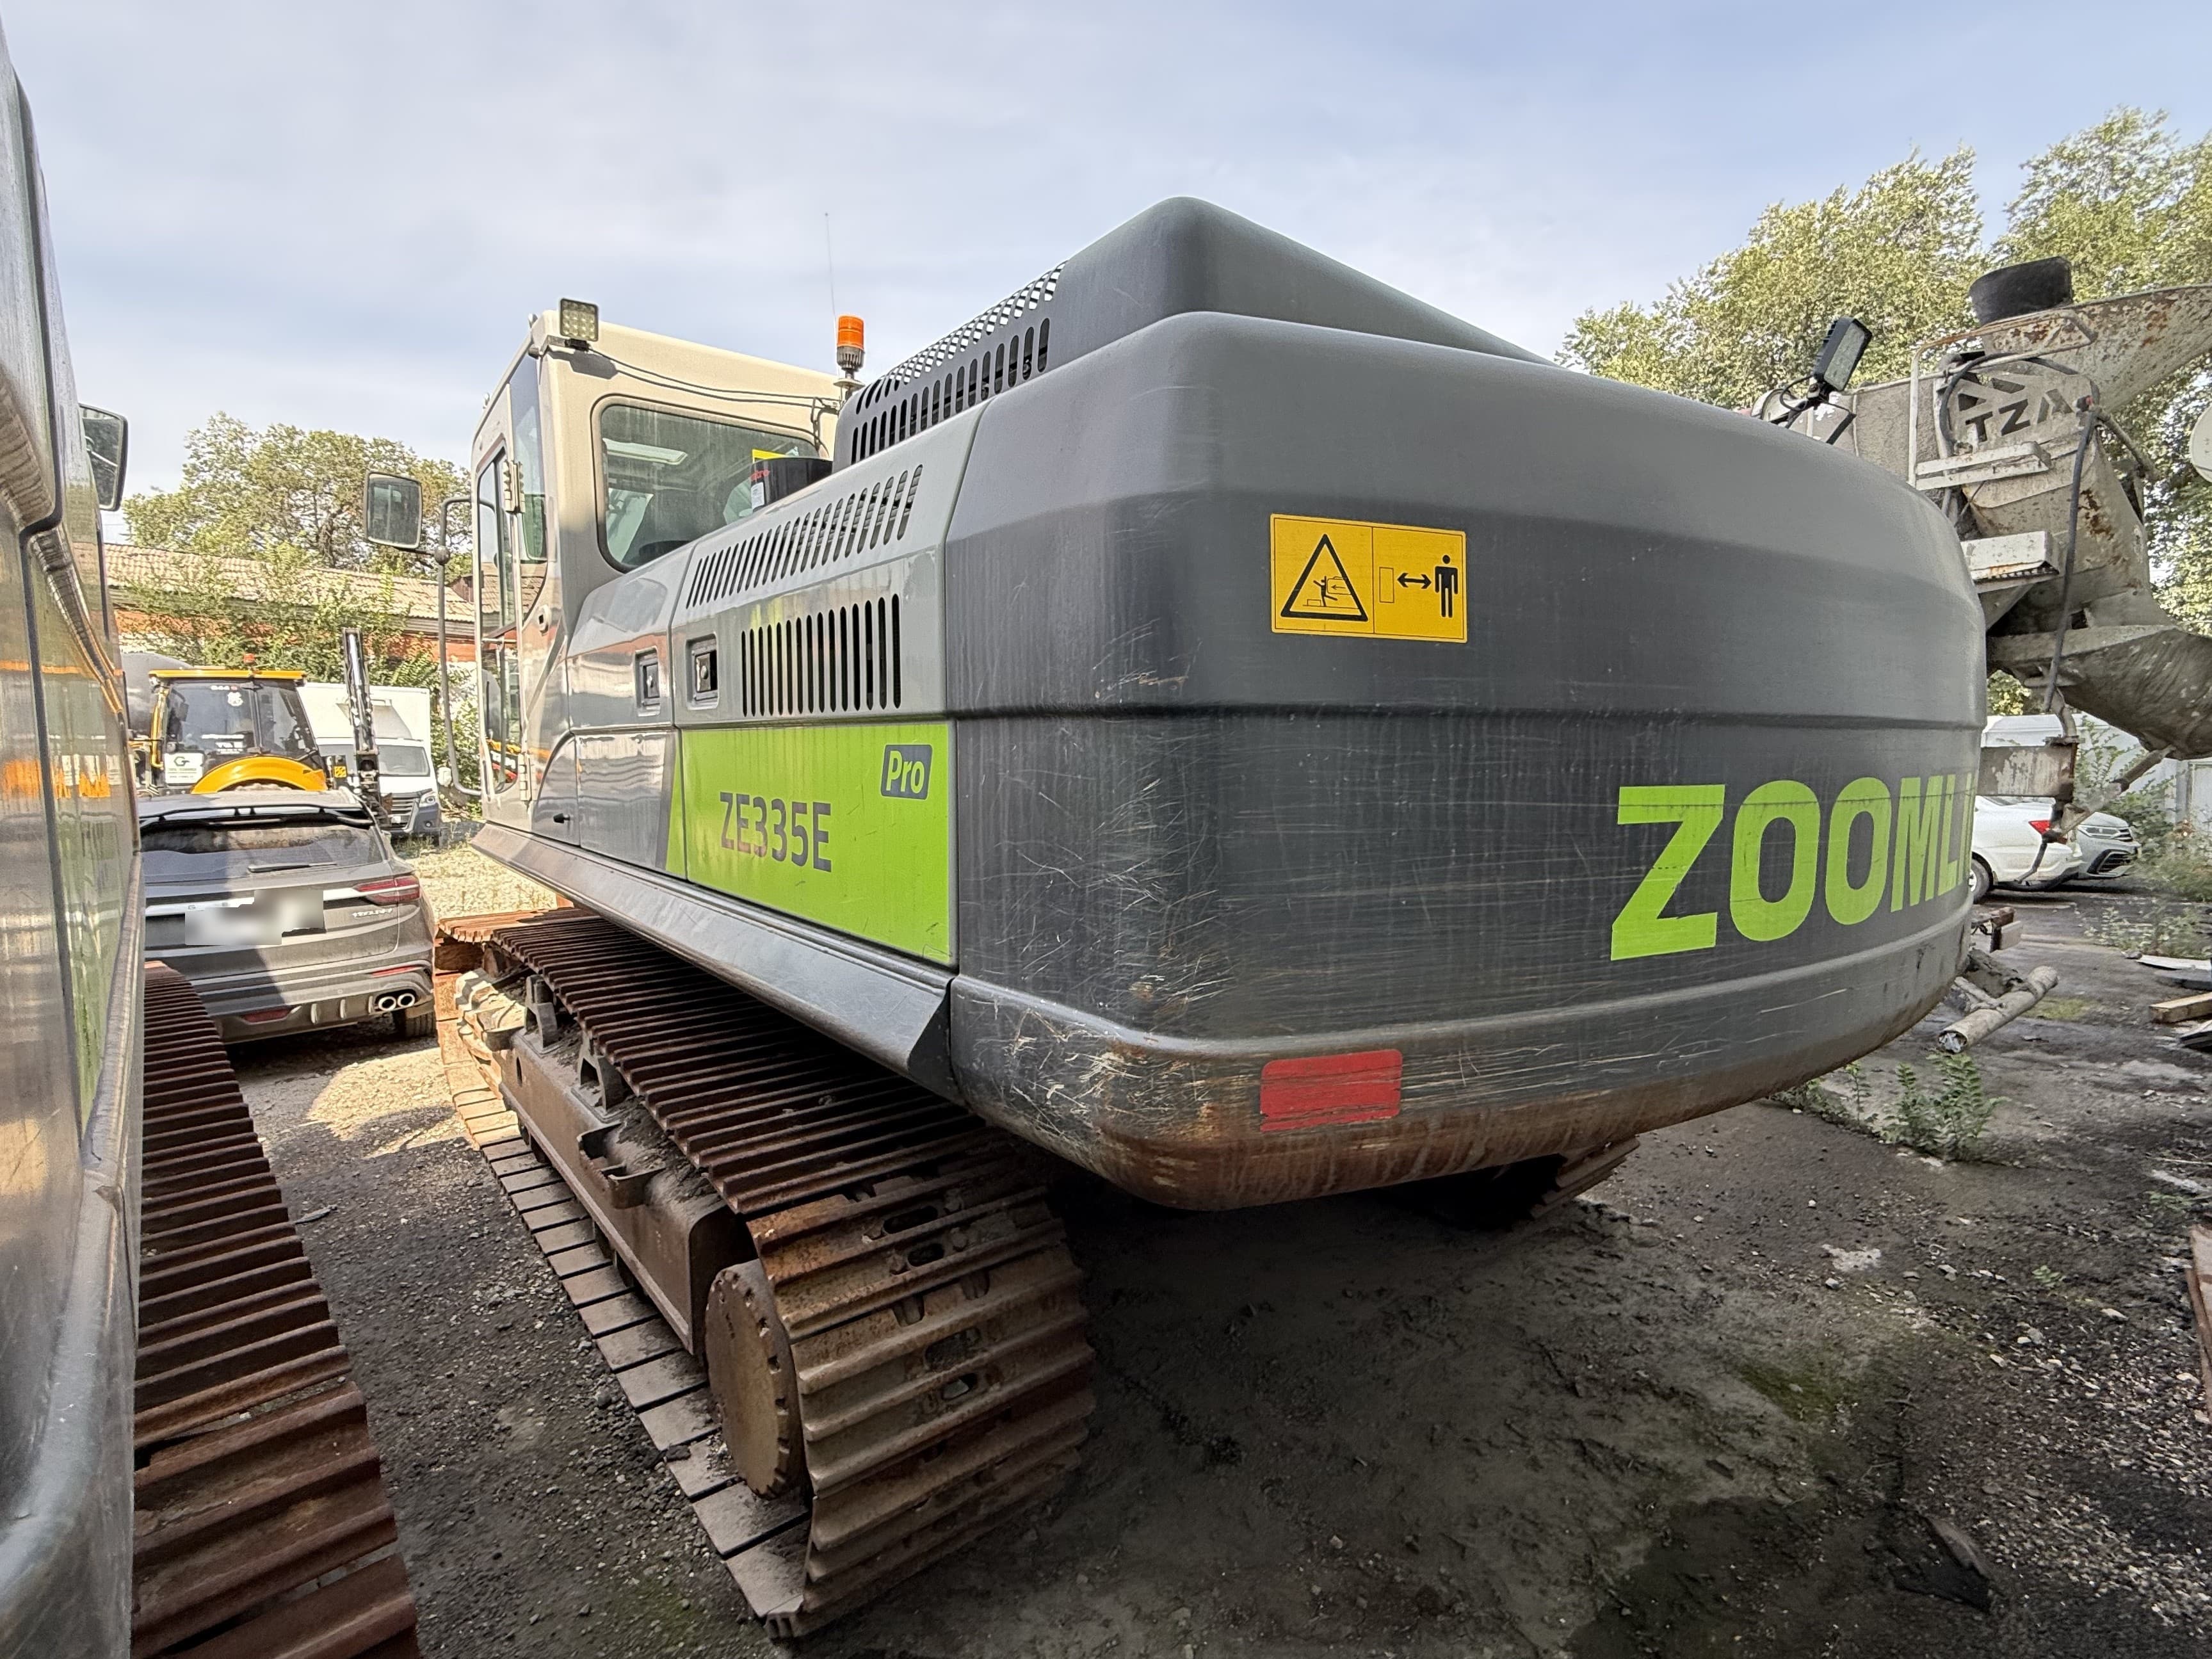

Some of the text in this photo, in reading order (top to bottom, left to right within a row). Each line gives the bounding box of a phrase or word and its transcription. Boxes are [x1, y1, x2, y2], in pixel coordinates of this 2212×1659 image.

[886, 750, 924, 795] Pro
[720, 791, 832, 872] ZE335E
[1611, 772, 1977, 960] ZOOMLI
